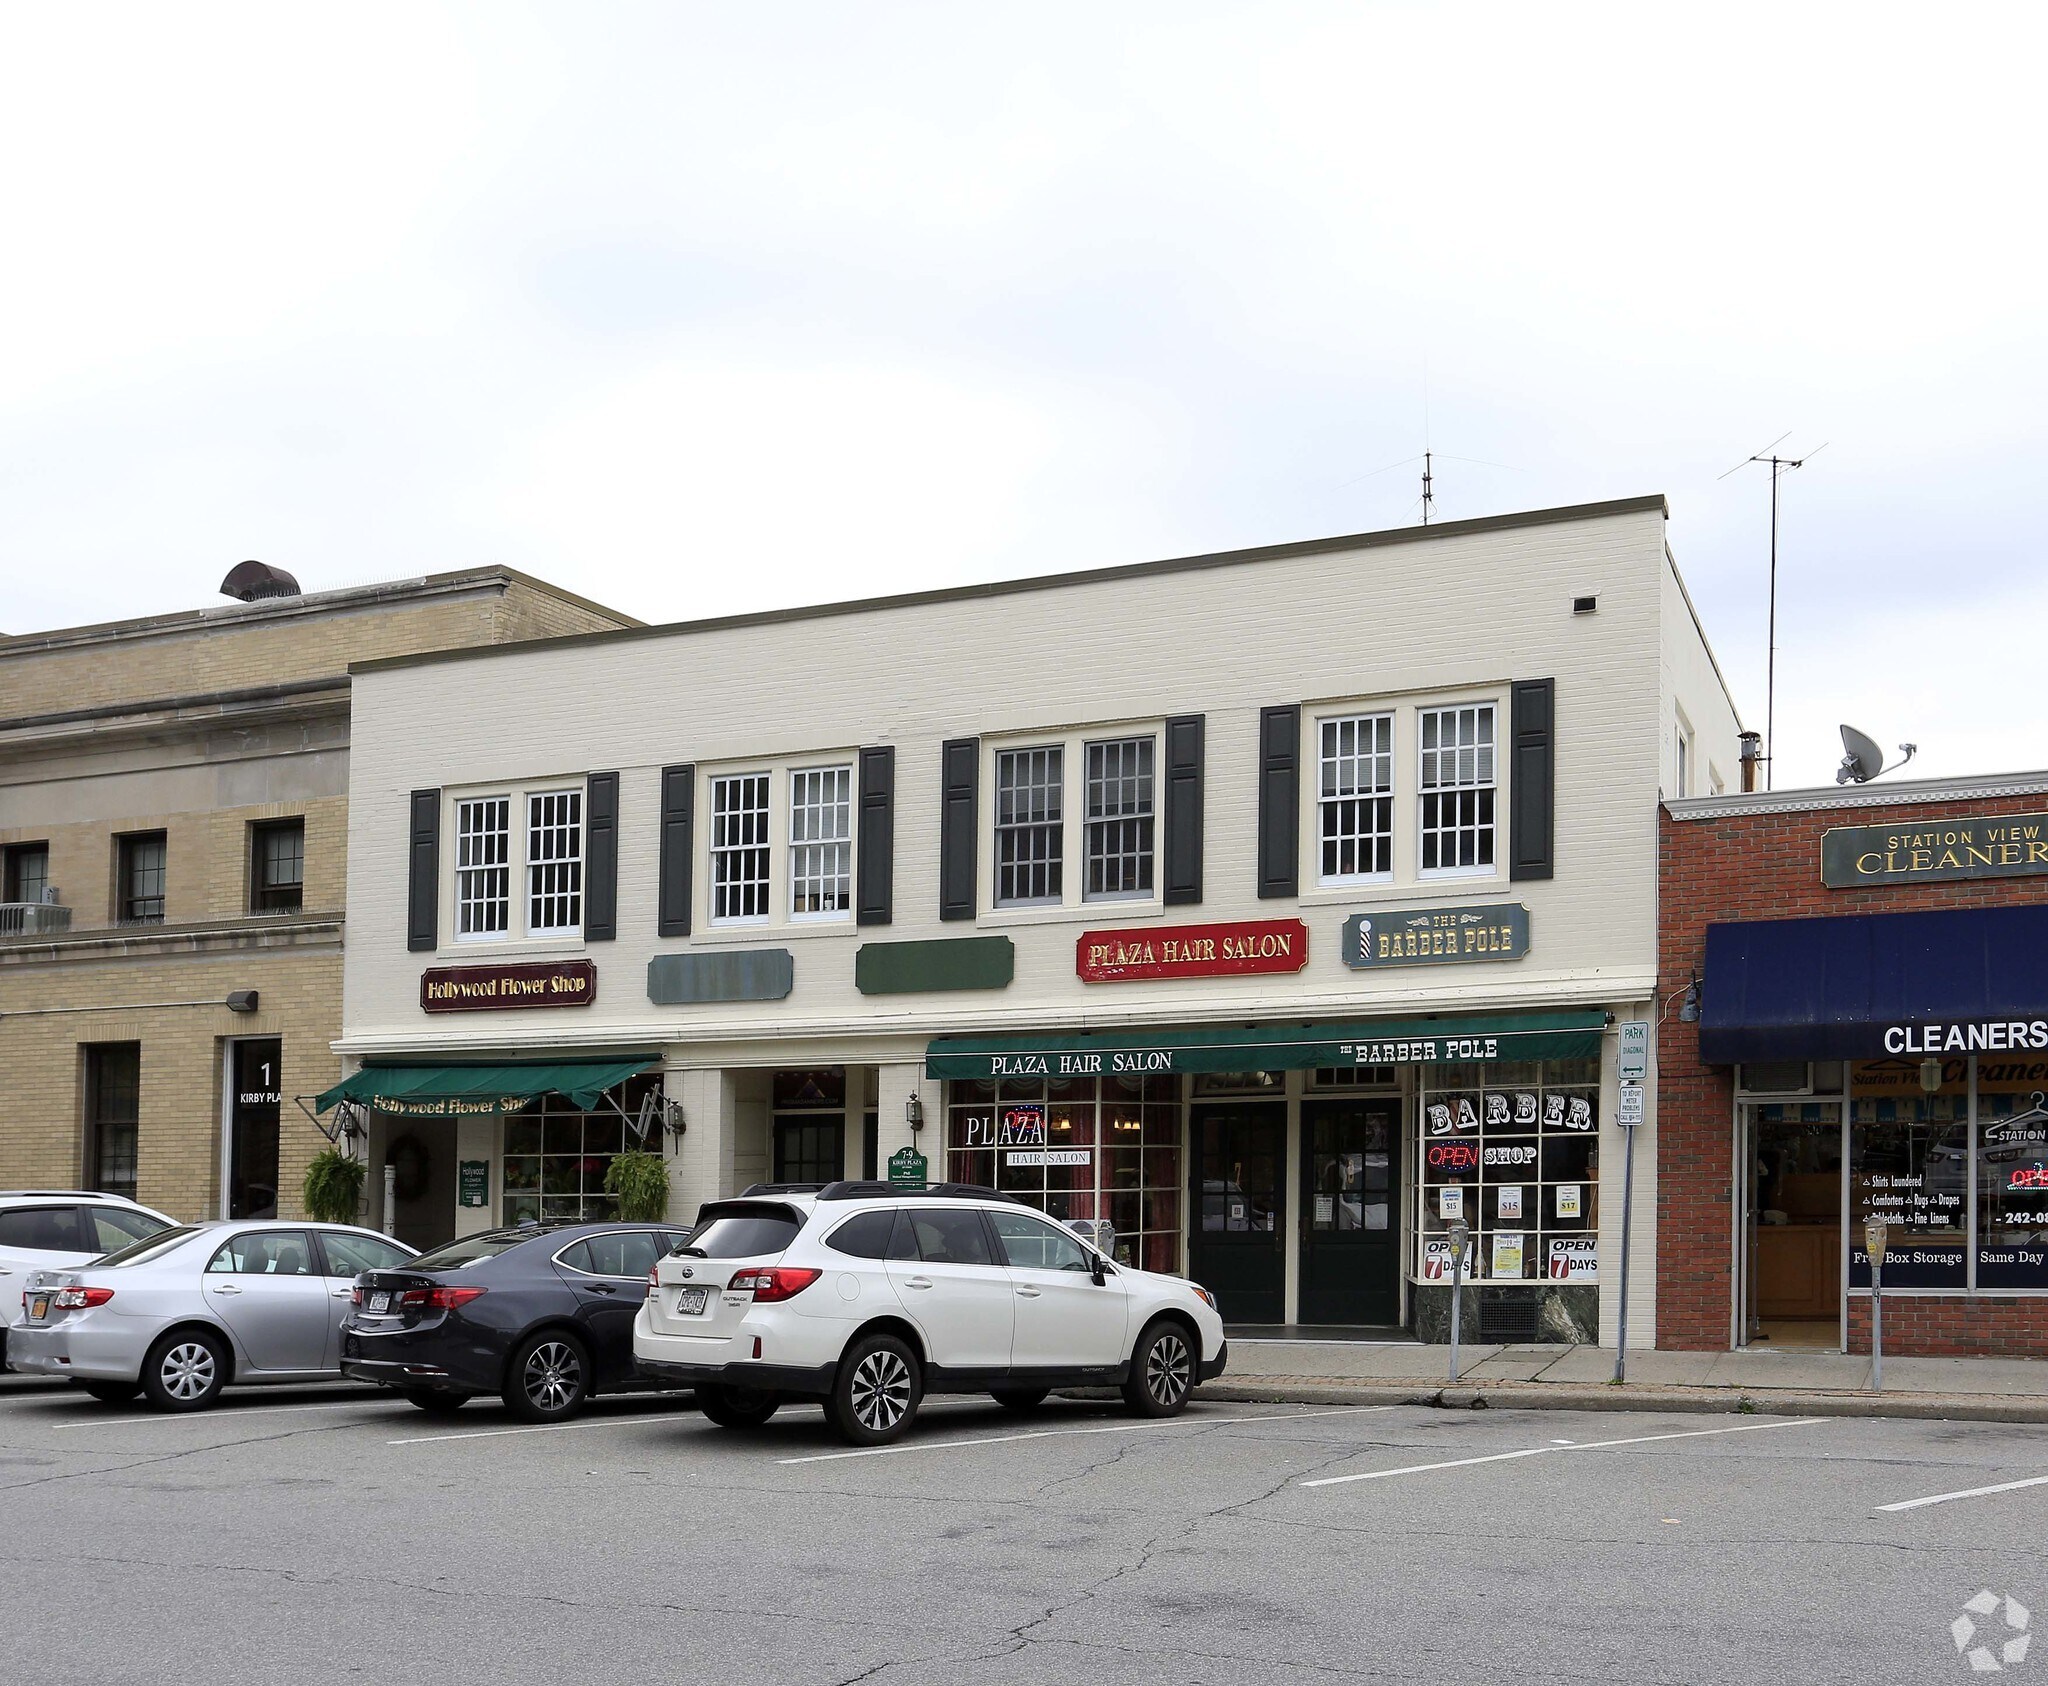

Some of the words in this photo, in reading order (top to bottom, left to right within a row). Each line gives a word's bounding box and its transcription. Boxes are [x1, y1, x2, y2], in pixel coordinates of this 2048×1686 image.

[1887, 831, 1972, 849] STATION
[1987, 826, 2040, 841] VIEW
[1855, 841, 2048, 875] CLEANER
[1433, 915, 1457, 927] THE
[1088, 941, 1156, 967] PLAZA
[1161, 938, 1217, 963] HAIR
[1222, 933, 1293, 960] SALON
[1378, 929, 1458, 958] BARBER
[1464, 925, 1513, 953] POLE
[428, 979, 497, 999] Hollywood
[501, 977, 547, 995] Flower
[550, 975, 586, 994] Shop
[1624, 1028, 1644, 1040] PARK
[1884, 1021, 2048, 1054] CLEANERS
[1355, 1042, 1437, 1063] BARBER
[1445, 1039, 1498, 1059] POLE
[1622, 1046, 1645, 1055] DIAGONAL
[990, 1056, 1049, 1075] PLAZA
[1059, 1054, 1102, 1074] HAIR
[1112, 1051, 1172, 1072] SALON
[261, 1062, 270, 1086] 1
[1902, 1072, 1921, 1085] Vie
[240, 1092, 266, 1103] KIRBY
[373, 1094, 445, 1115] Hollywood
[448, 1099, 496, 1114] Flower
[500, 1097, 531, 1111] Sho
[1427, 1092, 1591, 1135] BARBER
[965, 1116, 1044, 1146] PLAZA
[1998, 1130, 2046, 1141] STATION
[902, 1150, 914, 1159] 7-9
[1012, 1154, 1041, 1164] HAIR
[1048, 1152, 1087, 1163] SALON
[1428, 1146, 1479, 1166] OPEN
[1484, 1146, 1537, 1165] SHOP
[1234, 1162, 1242, 1185] 7
[1872, 1174, 1889, 1188] Shirts
[1891, 1173, 1923, 1187] Laundered
[1446, 1202, 1457, 1210] $15
[1502, 1201, 1518, 1211] $15
[1872, 1193, 1904, 1206] Comforters
[1914, 1193, 1929, 1209] Rugs
[1938, 1193, 1960, 1208] Drapes
[1873, 1211, 1905, 1225] ecloths
[1914, 1212, 1928, 1224] Fine
[1930, 1212, 1950, 1225] Linens
[1552, 1241, 1597, 1251] OPEN
[1426, 1255, 1442, 1279] 7
[1443, 1260, 1470, 1272] DAS
[1552, 1254, 1568, 1279] 7
[1569, 1259, 1598, 1271] DAYS
[1885, 1252, 1910, 1264] Box
[1913, 1251, 1963, 1266] Storage
[1980, 1251, 2015, 1264] Same
[2018, 1251, 2045, 1265] Day
